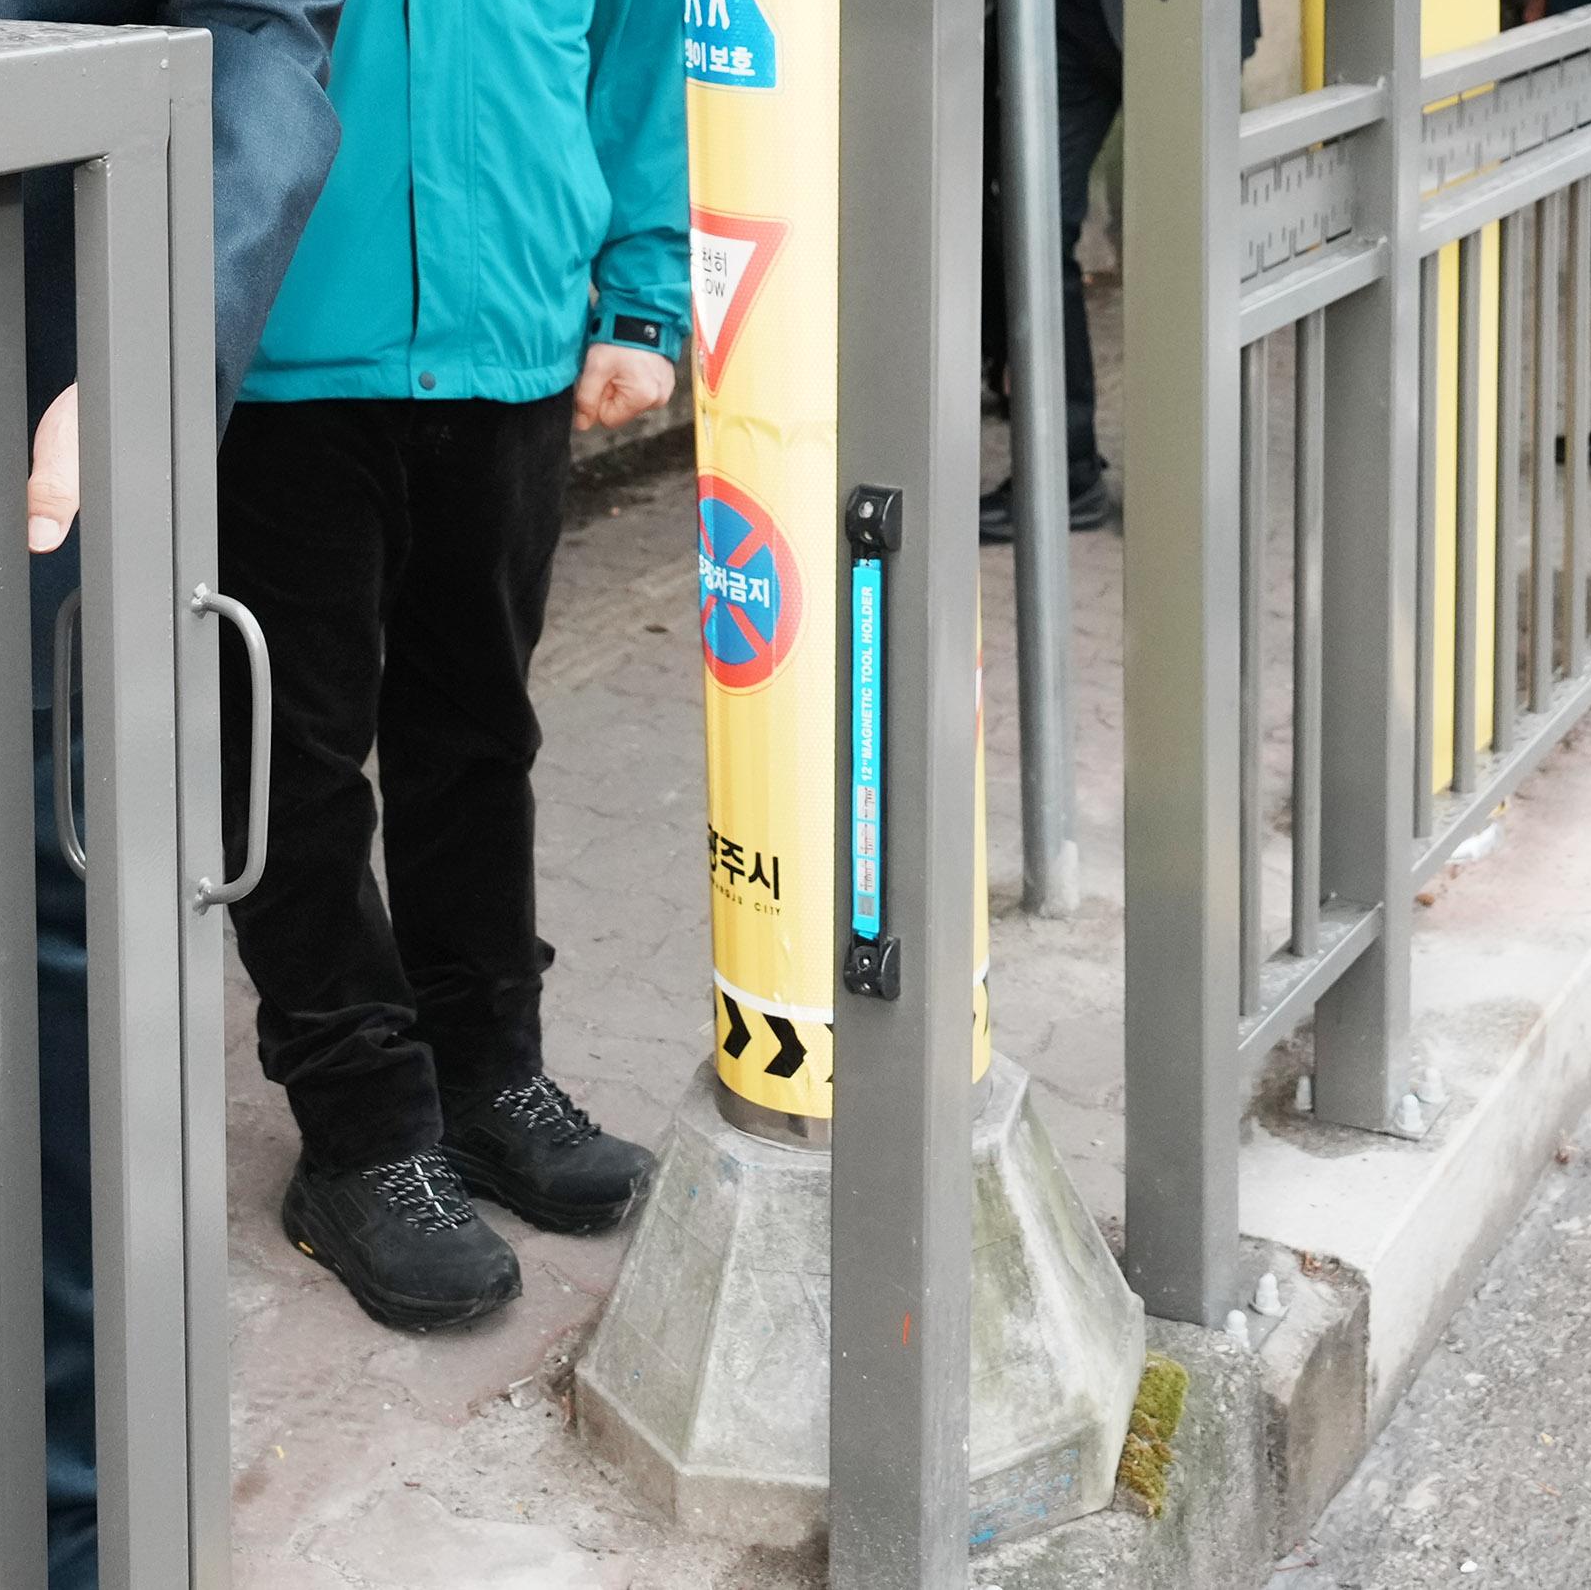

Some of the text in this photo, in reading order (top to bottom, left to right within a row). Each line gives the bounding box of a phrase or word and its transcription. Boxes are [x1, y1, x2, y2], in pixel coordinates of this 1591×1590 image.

[709, 44, 756, 76] 보호
[861, 585, 874, 645] HOLDER
[861, 646, 874, 684] TOOL
